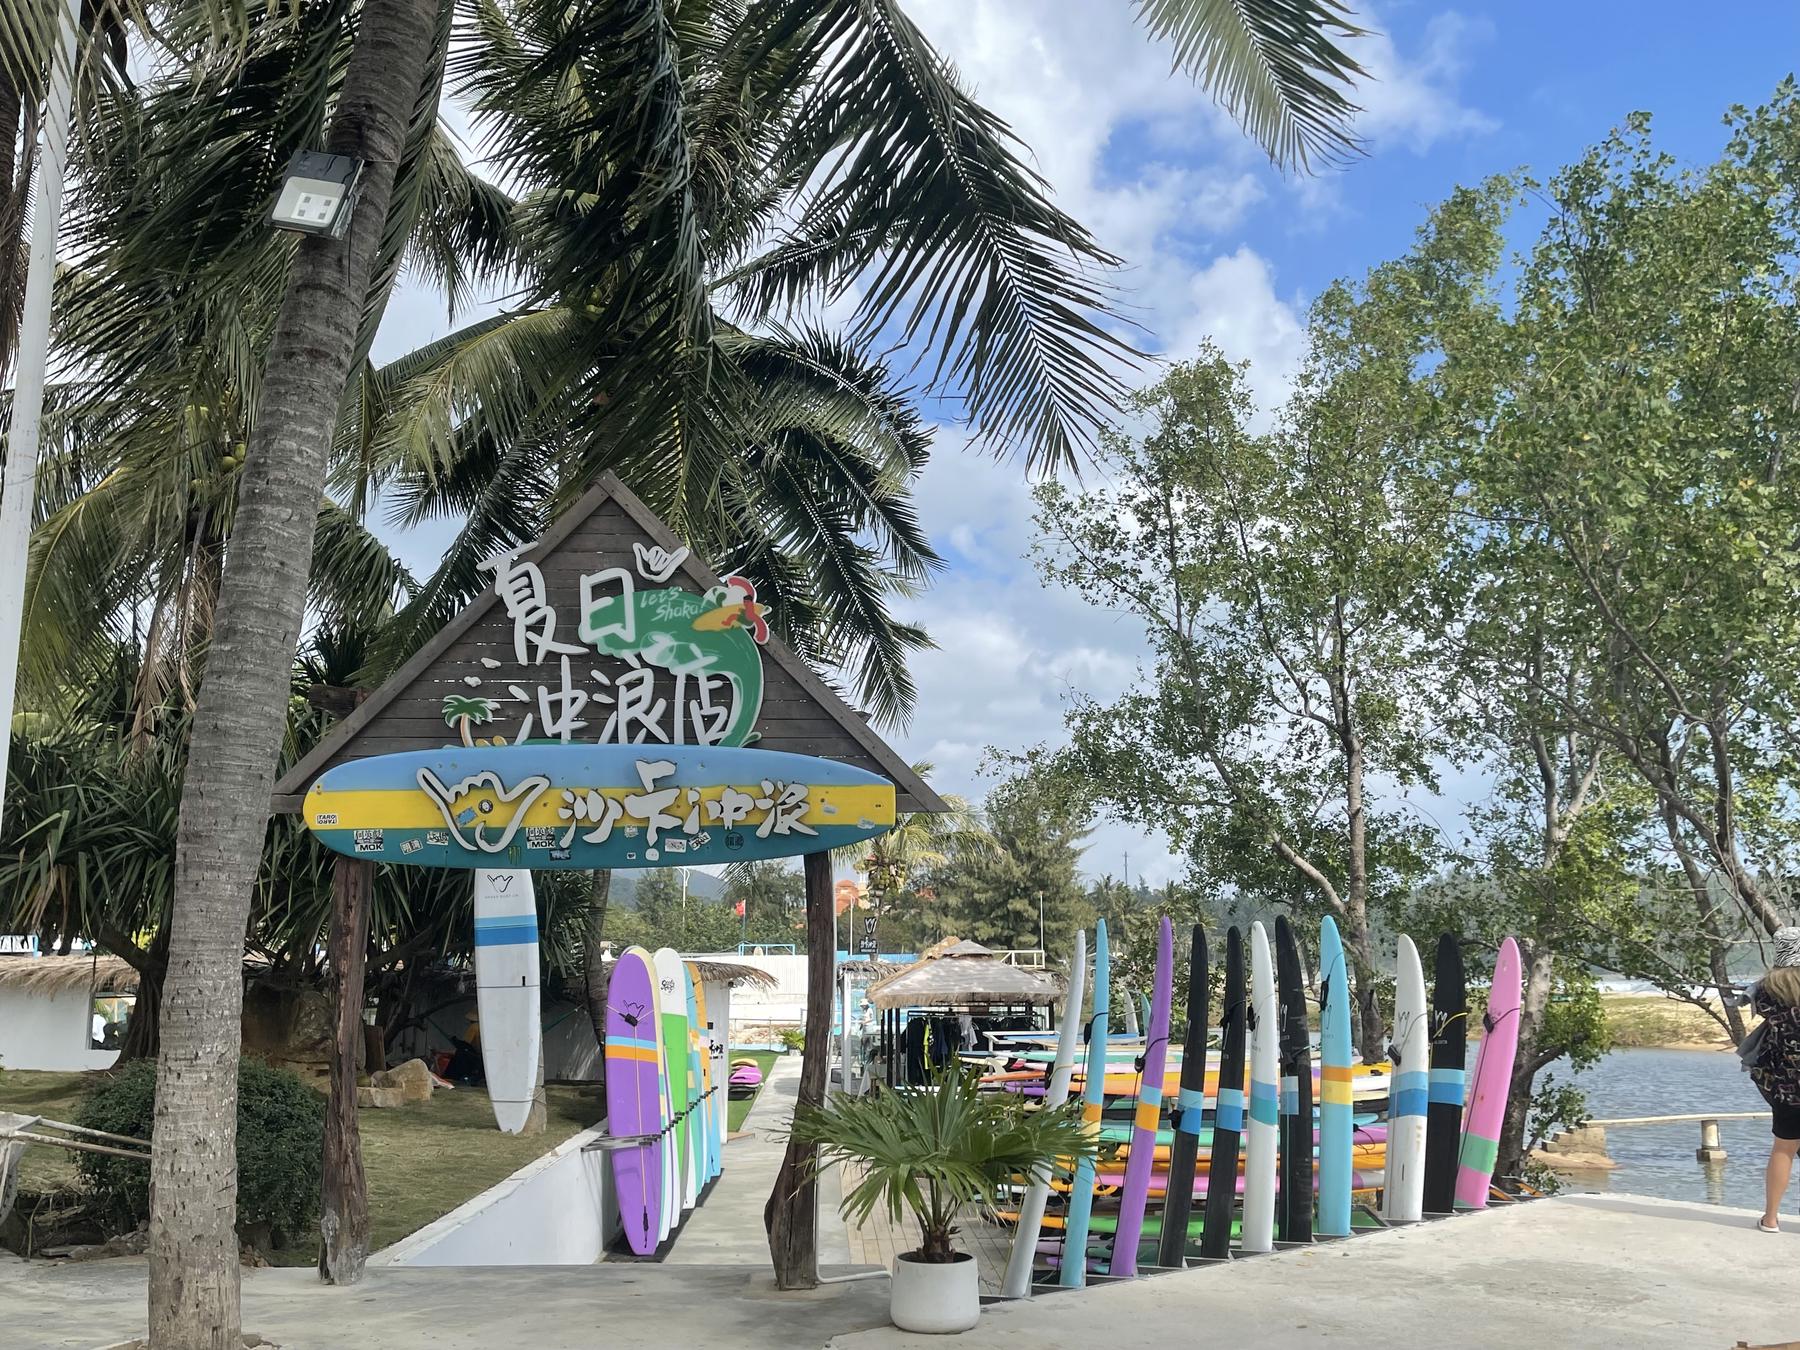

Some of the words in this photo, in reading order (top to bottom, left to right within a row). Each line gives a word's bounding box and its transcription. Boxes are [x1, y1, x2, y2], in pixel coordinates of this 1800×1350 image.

[476, 541, 637, 666] 夏日
[508, 643, 729, 746] 冲浪店
[359, 843, 382, 851] MOK
[532, 840, 554, 848] MOK
[558, 760, 819, 848] 沙卡冲浪
